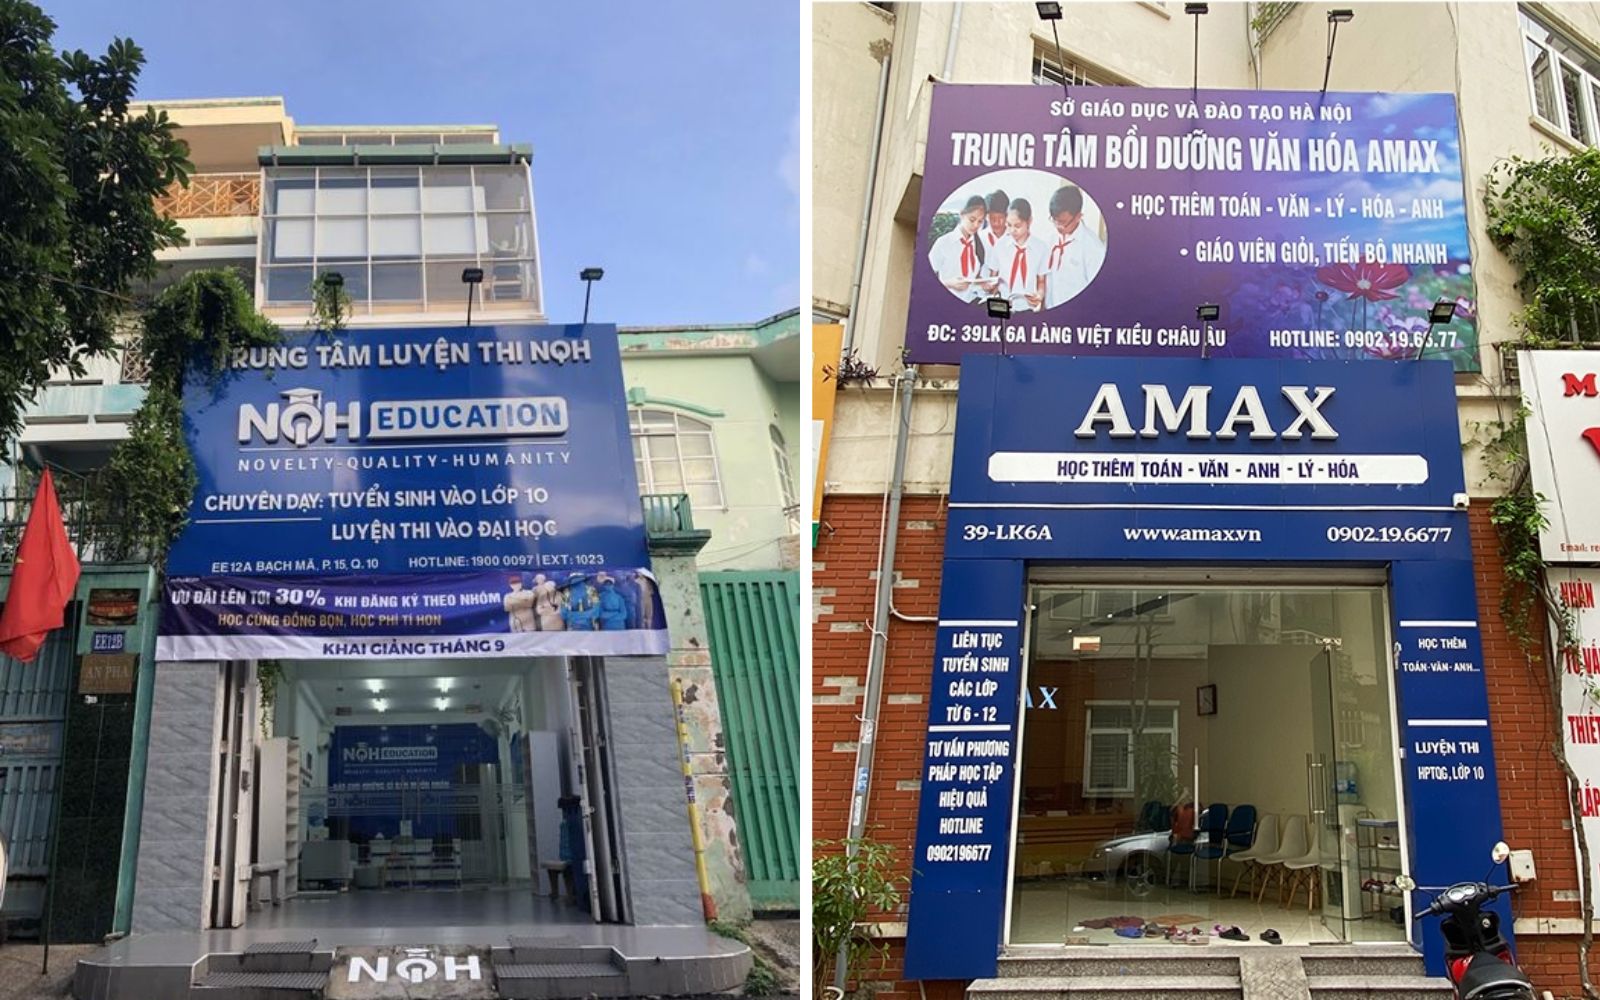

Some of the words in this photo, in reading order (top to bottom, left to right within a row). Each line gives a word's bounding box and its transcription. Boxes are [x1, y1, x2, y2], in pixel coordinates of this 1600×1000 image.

[1050, 97, 1075, 116] SỞ
[1081, 99, 1125, 117] GIÁO
[1131, 103, 1169, 121] DỤC
[1175, 101, 1199, 118] VÀ
[1204, 101, 1242, 119] ĐÀO
[1248, 105, 1283, 123] TẠO
[1289, 102, 1315, 120] HÀ
[1320, 103, 1352, 124] NỘI
[951, 132, 1035, 167] TRUNG
[1043, 127, 1097, 168] TÂM
[1105, 125, 1147, 169] BỒI
[1156, 129, 1242, 171] DƯỠNG
[1249, 131, 1300, 171] VĂN
[1308, 132, 1360, 172] HÓA
[1367, 139, 1440, 173] AMAX
[1131, 194, 1165, 220] HỌC
[1169, 191, 1215, 216] THÊM
[1219, 192, 1261, 217] TOÁN
[1278, 193, 1310, 217] VĂN
[1327, 193, 1345, 218] LÝ
[1362, 194, 1395, 219] HÓA
[1411, 199, 1444, 219] ANH
[1196, 236, 1234, 262] GIÁO
[1239, 237, 1276, 263] VIÊN
[1281, 236, 1320, 267] GIỎI,
[1324, 235, 1360, 264] TIẾN
[1365, 239, 1387, 268] BỘ
[1392, 243, 1448, 265] NHANH
[927, 324, 957, 341] ĐC:
[1031, 322, 1072, 344] LÀNG
[1077, 323, 1112, 348] VIỆT
[1157, 325, 1200, 346] CHÂU
[1270, 330, 1341, 347] HOTLINE:
[220, 345, 309, 368] RUNG
[316, 340, 371, 368] TÂM
[378, 337, 470, 370] LUYỆN
[478, 342, 524, 364] THI
[530, 339, 592, 364] NQH
[378, 403, 561, 430] EDUCATION
[1074, 383, 1338, 440] AMAX
[1057, 461, 1088, 479] HỌC
[1092, 458, 1134, 476] THÊM
[1141, 458, 1182, 477] TOÁN
[1198, 459, 1228, 478] VĂN
[1247, 462, 1280, 478] ANH
[1298, 459, 1314, 478] LÝ
[1328, 459, 1359, 478] HÓA
[205, 490, 282, 511] CHUYÊN
[286, 492, 324, 512] DẠY:
[328, 483, 390, 508] TUYỂN
[394, 490, 435, 507] SINH
[440, 485, 476, 506] VÀO
[482, 484, 518, 504] LỚP
[525, 487, 548, 503] 10
[332, 519, 395, 543] LUYỆN
[400, 522, 431, 539] THI
[436, 517, 472, 538] VÀO
[477, 520, 510, 540] ĐẠI
[516, 519, 558, 541] HỌC
[963, 524, 1053, 541] 39-LK6A
[1123, 526, 1262, 543] www.amax.vn
[1326, 525, 1452, 543] 0902.19.6677
[256, 561, 292, 574] BẠCH
[367, 558, 378, 569] 10
[409, 556, 469, 568] HOTLINE:
[471, 556, 499, 567] 1900
[503, 555, 533, 566] 0097
[576, 554, 604, 565] 1023
[221, 588, 246, 605] LÊN
[275, 588, 326, 606] 30%
[335, 596, 357, 608] KHI
[361, 594, 397, 608] ĐĂNG
[402, 592, 420, 607] KÝ
[423, 594, 456, 606] THEO
[416, 612, 442, 626] HON
[323, 643, 366, 655] KHAI
[371, 639, 426, 655] GIẢNG
[430, 638, 491, 654] THÁNG
[495, 640, 505, 652] 9
[953, 630, 978, 648] LIÊN
[981, 633, 1003, 651] TỤC
[1418, 638, 1438, 650] HỌC
[1440, 636, 1467, 649] THÊM
[943, 651, 978, 672] TUYỂN
[981, 657, 1009, 672] SINH
[1582, 638, 1600, 675] VẤ
[949, 678, 973, 696] CÁC
[976, 678, 998, 696] LỚP
[946, 703, 962, 722] TỪ
[963, 707, 971, 722] 6
[982, 706, 997, 722] 12
[929, 740, 943, 757] TƯ
[944, 737, 965, 757] VẤN
[966, 740, 1010, 757] PHƯƠNG
[1415, 739, 1456, 756] LUYỆN
[1459, 742, 1480, 754] THI
[928, 762, 957, 781] PHÁP
[959, 765, 980, 784] HỌC
[983, 762, 1003, 784] TẬP
[1473, 766, 1484, 780] 10
[939, 788, 964, 811] HIỆU
[966, 786, 987, 809] QUẢ
[940, 818, 984, 834] HOTLINE
[927, 845, 992, 861] 0902196677
